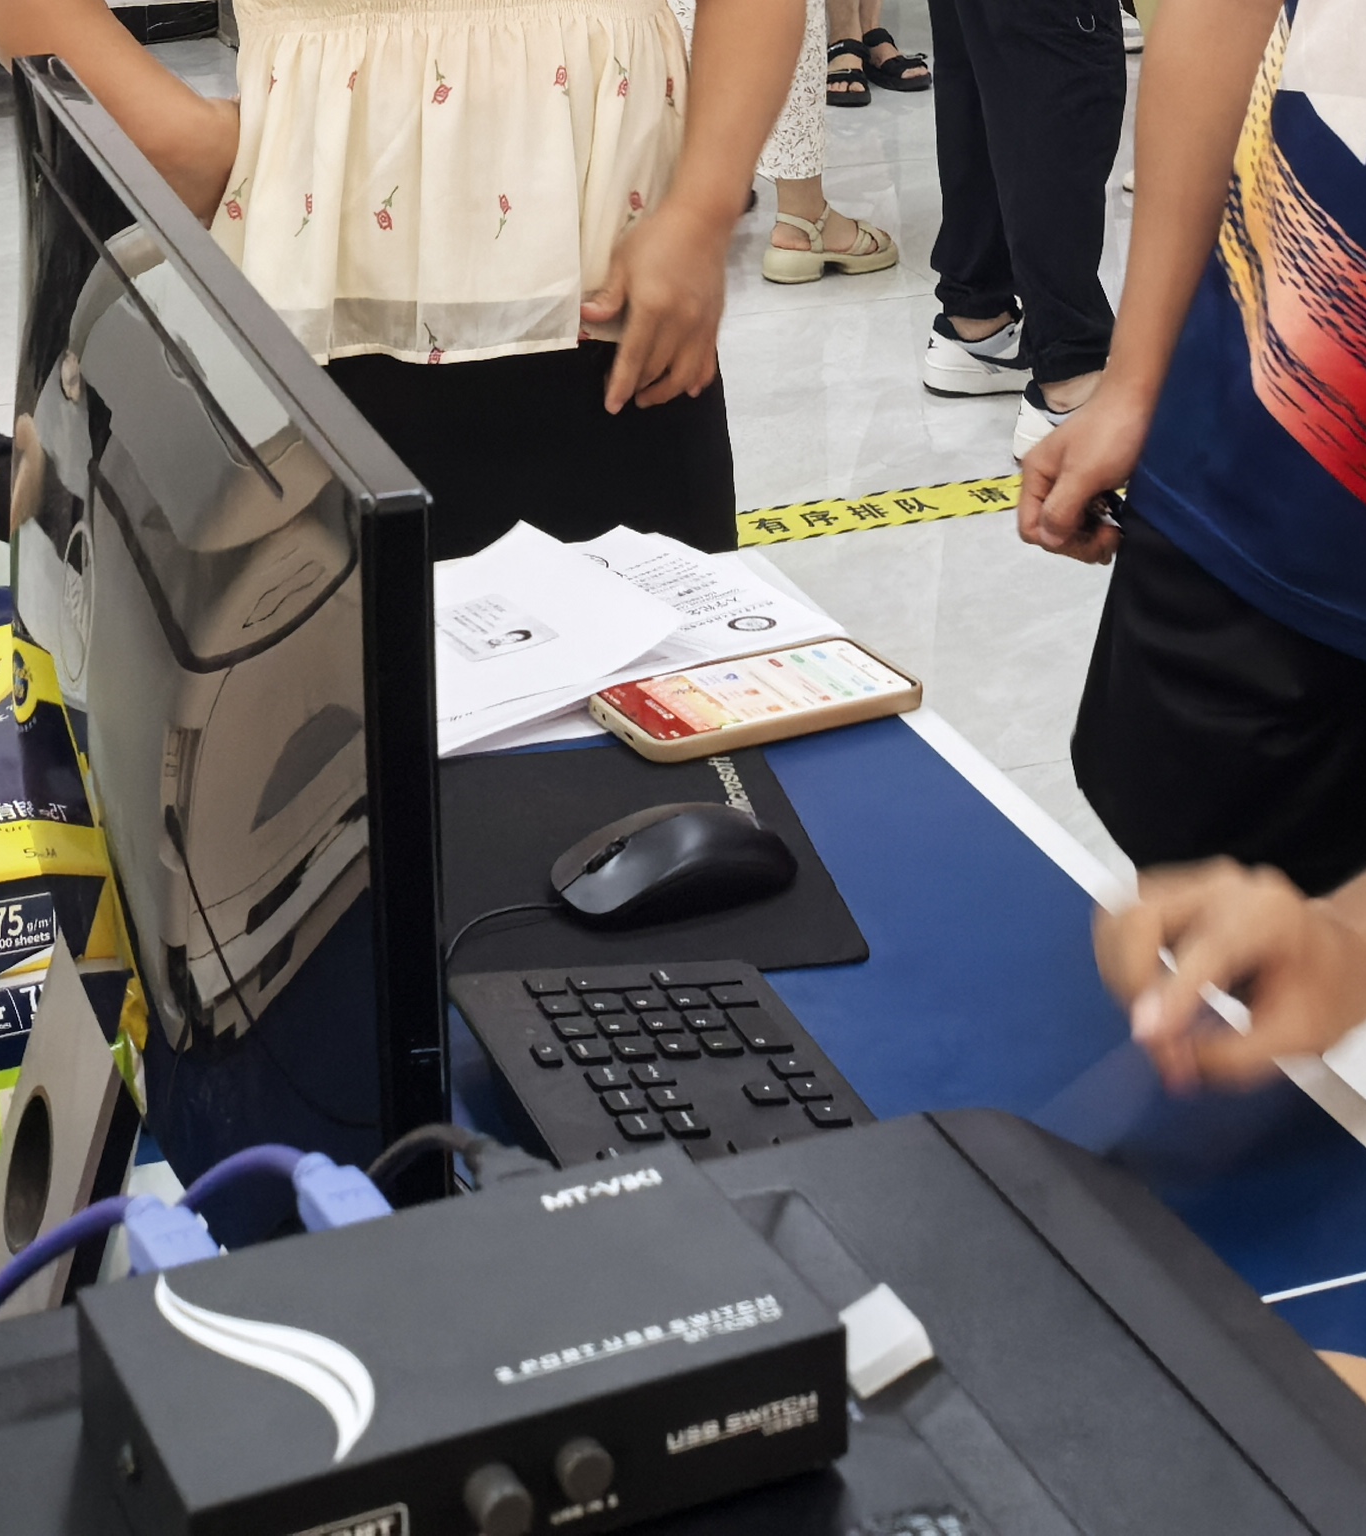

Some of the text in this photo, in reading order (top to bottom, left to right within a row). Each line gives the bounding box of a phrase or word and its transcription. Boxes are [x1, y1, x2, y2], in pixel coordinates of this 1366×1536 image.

[748, 496, 939, 535] 有序排队
[14, 930, 51, 947] sheets
[19, 984, 44, 1014] 7
